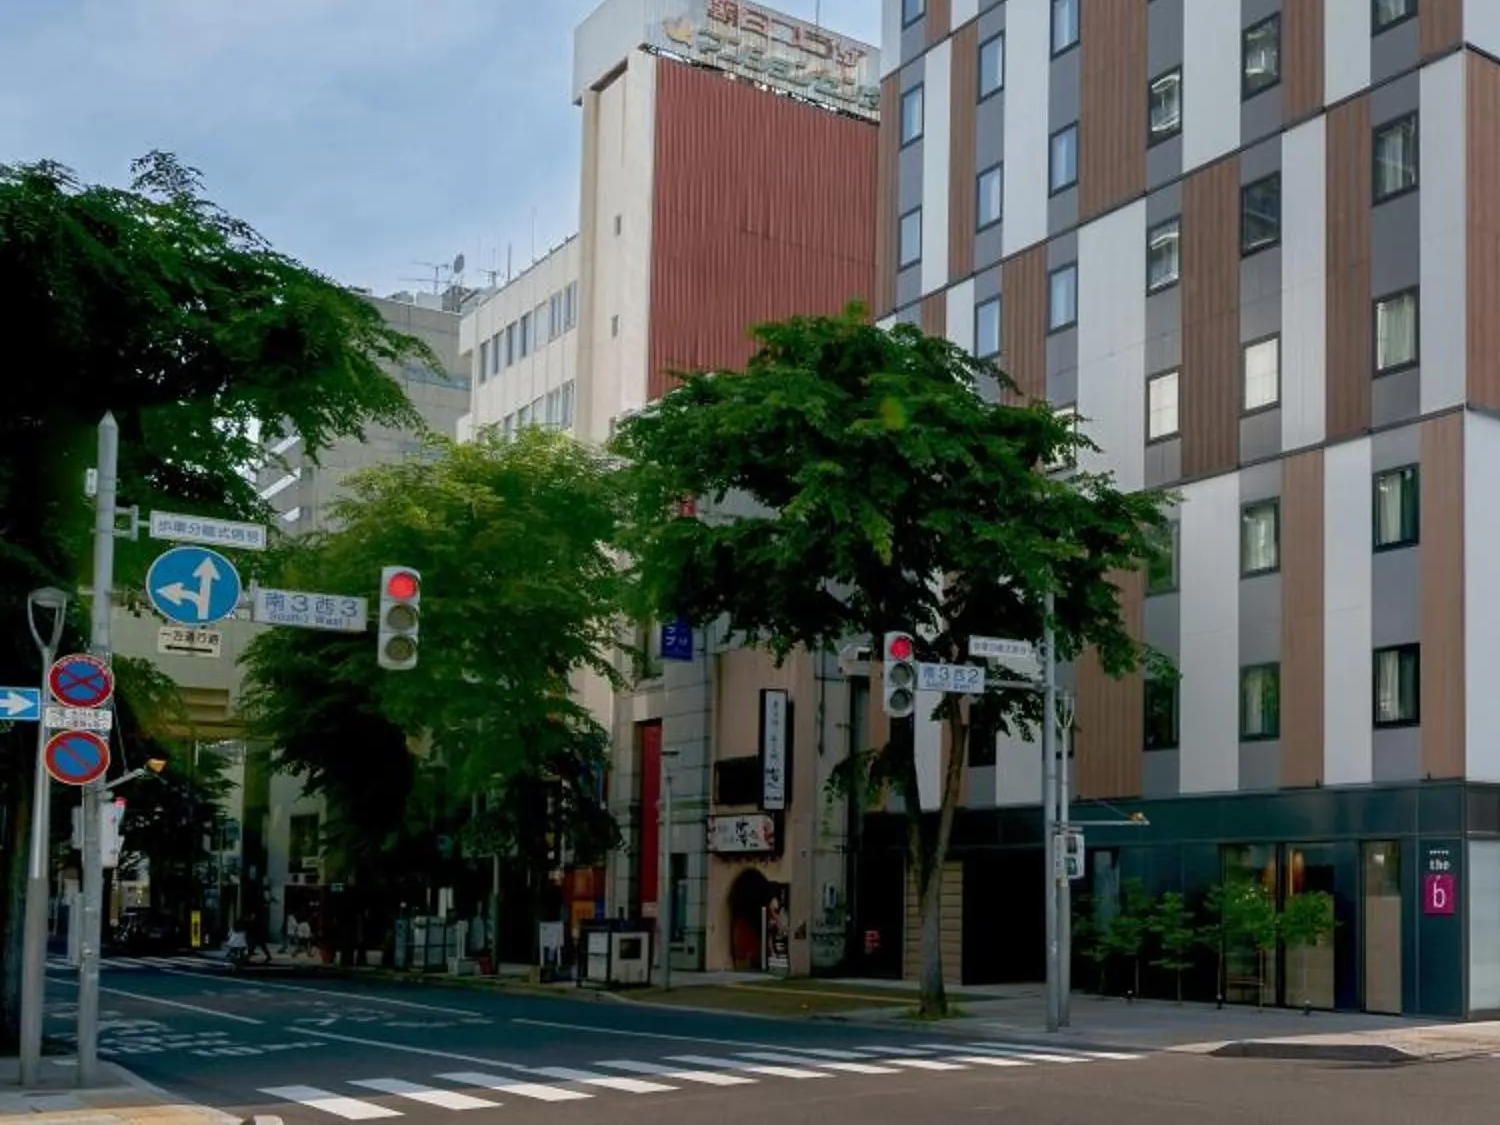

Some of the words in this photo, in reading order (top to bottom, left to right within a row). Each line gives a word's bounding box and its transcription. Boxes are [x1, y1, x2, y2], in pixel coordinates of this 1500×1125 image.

[265, 592, 358, 618] 南3西3
[1429, 858, 1451, 871] the
[1433, 881, 1446, 908] b
